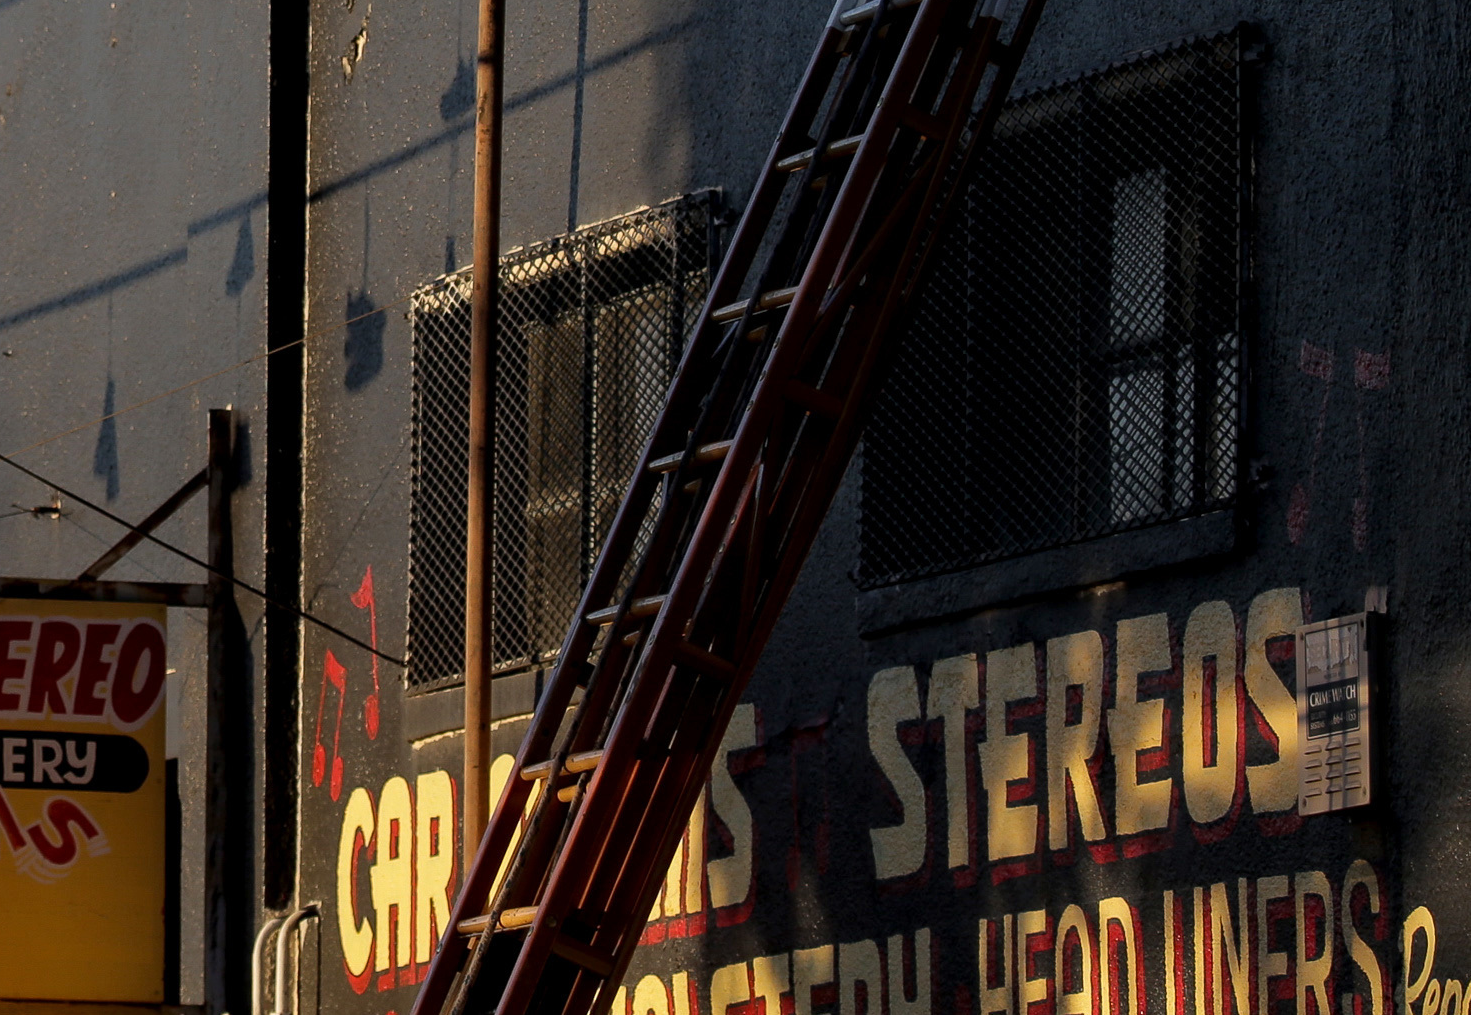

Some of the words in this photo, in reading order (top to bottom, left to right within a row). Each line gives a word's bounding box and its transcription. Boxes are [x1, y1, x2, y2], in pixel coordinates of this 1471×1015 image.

[867, 588, 1302, 879] STEREOS
[1310, 690, 1331, 707] CRIME
[1332, 685, 1356, 702] WATCH
[336, 769, 455, 980] CAR
